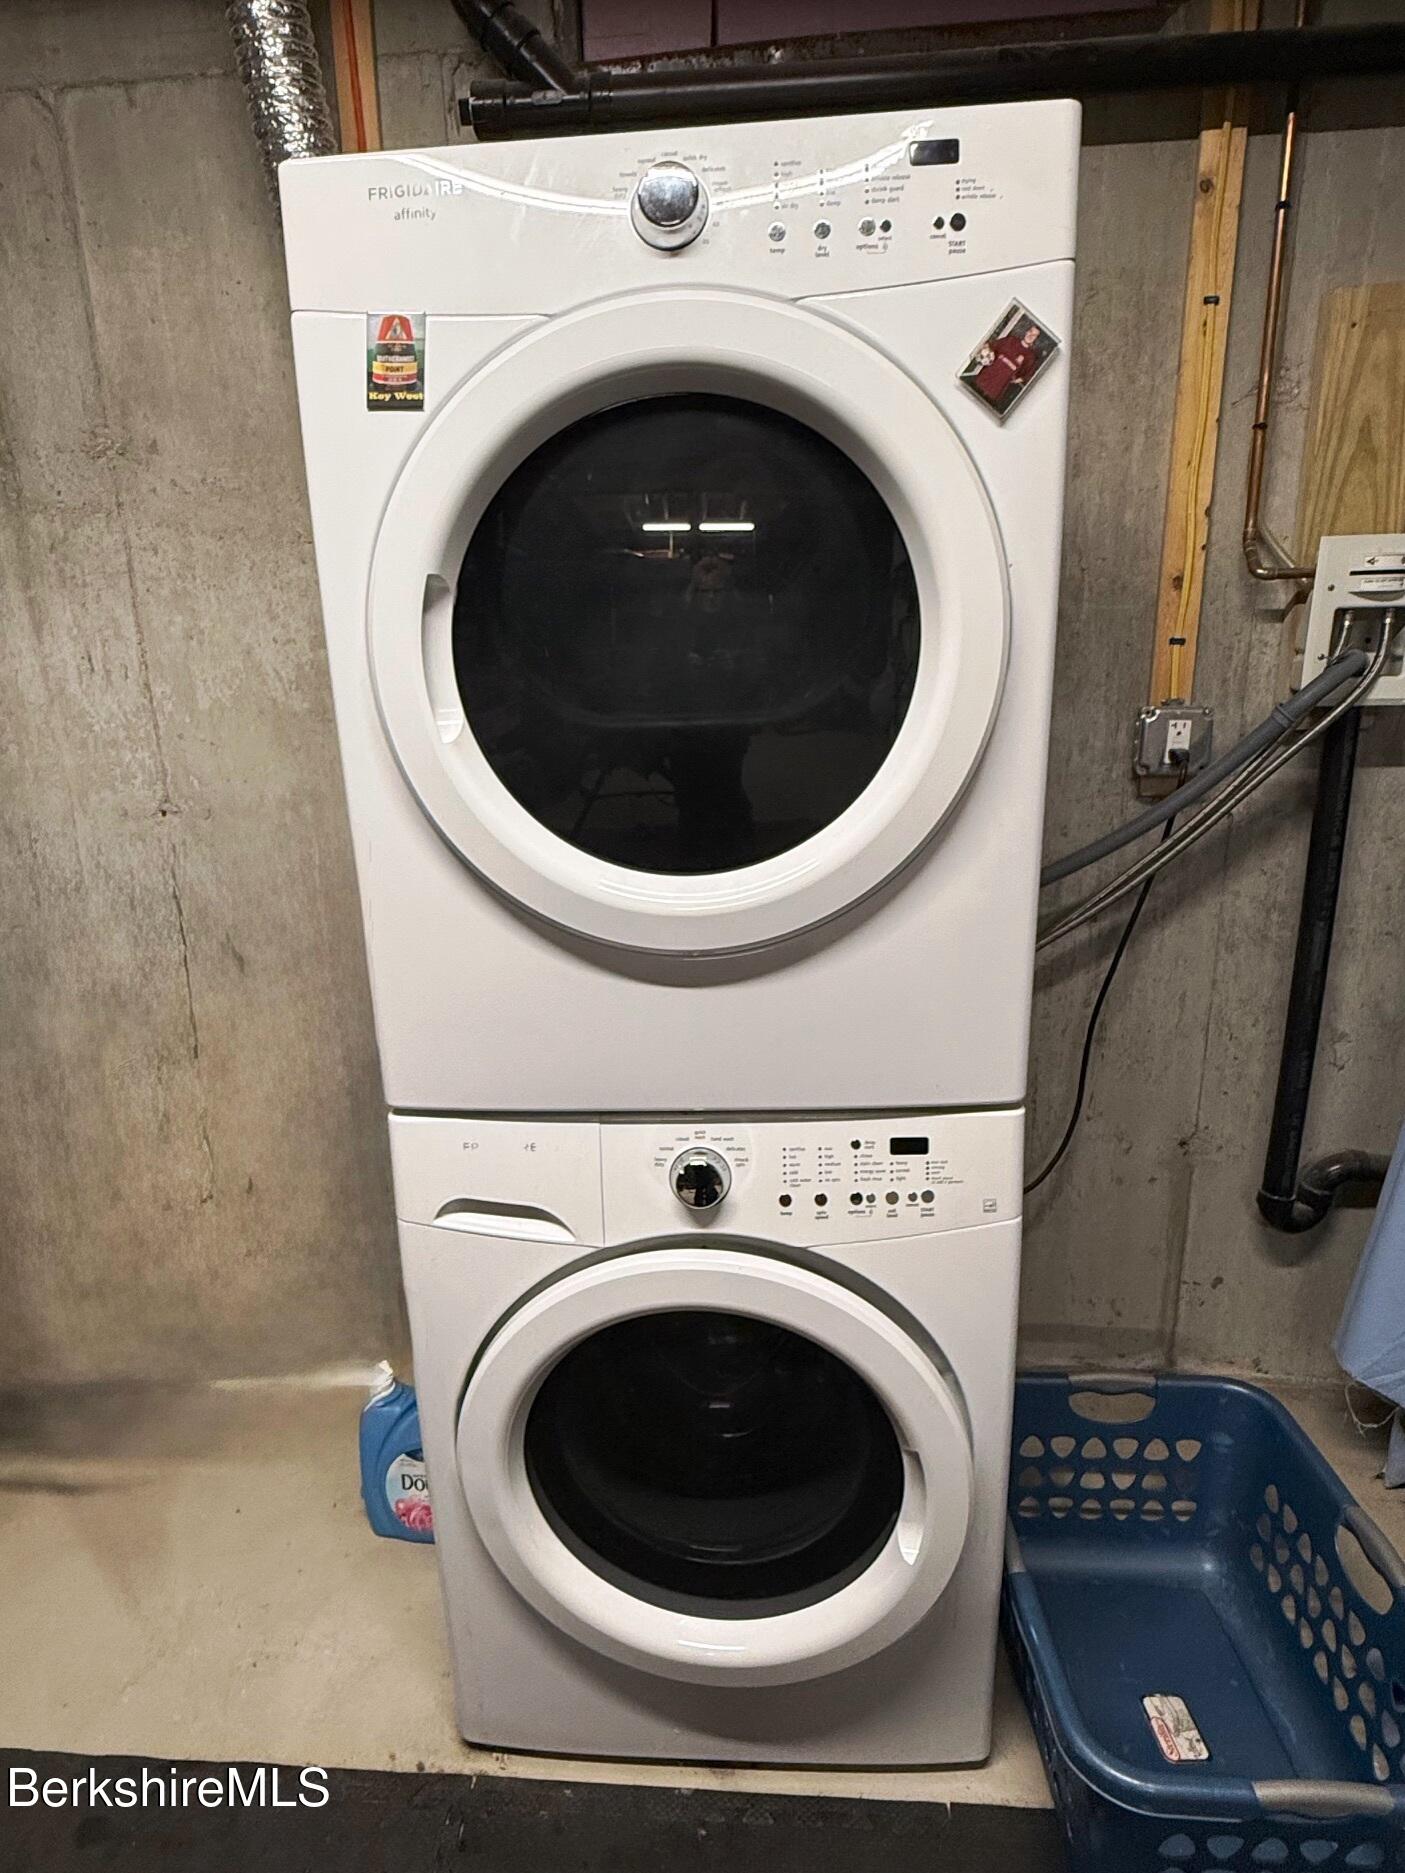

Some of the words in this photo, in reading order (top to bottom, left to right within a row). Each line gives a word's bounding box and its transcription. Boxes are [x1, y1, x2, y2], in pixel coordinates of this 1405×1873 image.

[393, 207, 437, 221] affinity
[856, 243, 879, 251] options
[368, 391, 392, 402] Key
[394, 391, 424, 400] West
